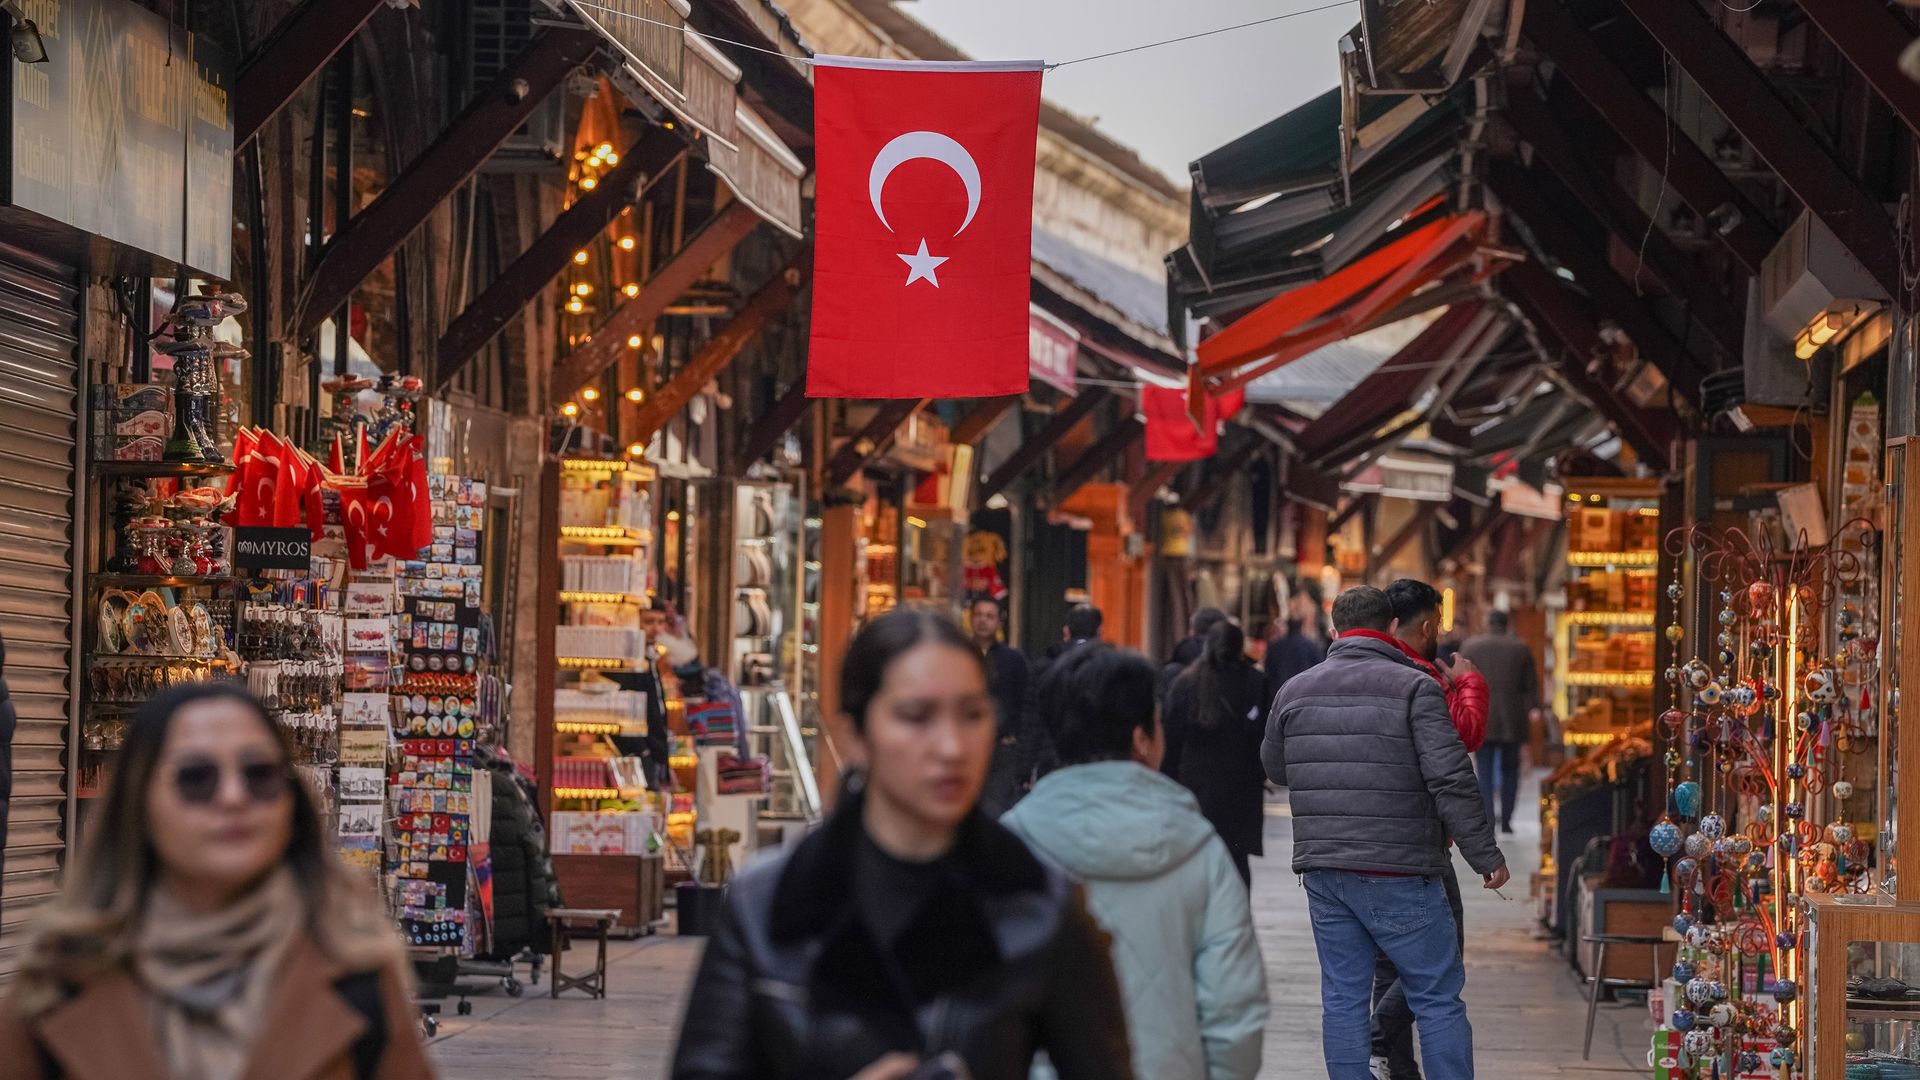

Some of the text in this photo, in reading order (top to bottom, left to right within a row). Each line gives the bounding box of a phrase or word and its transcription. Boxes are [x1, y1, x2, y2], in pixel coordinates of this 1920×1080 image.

[19, 0, 60, 40] arpet
[19, 126, 65, 191] Cushion
[252, 541, 308, 557] MYROS
